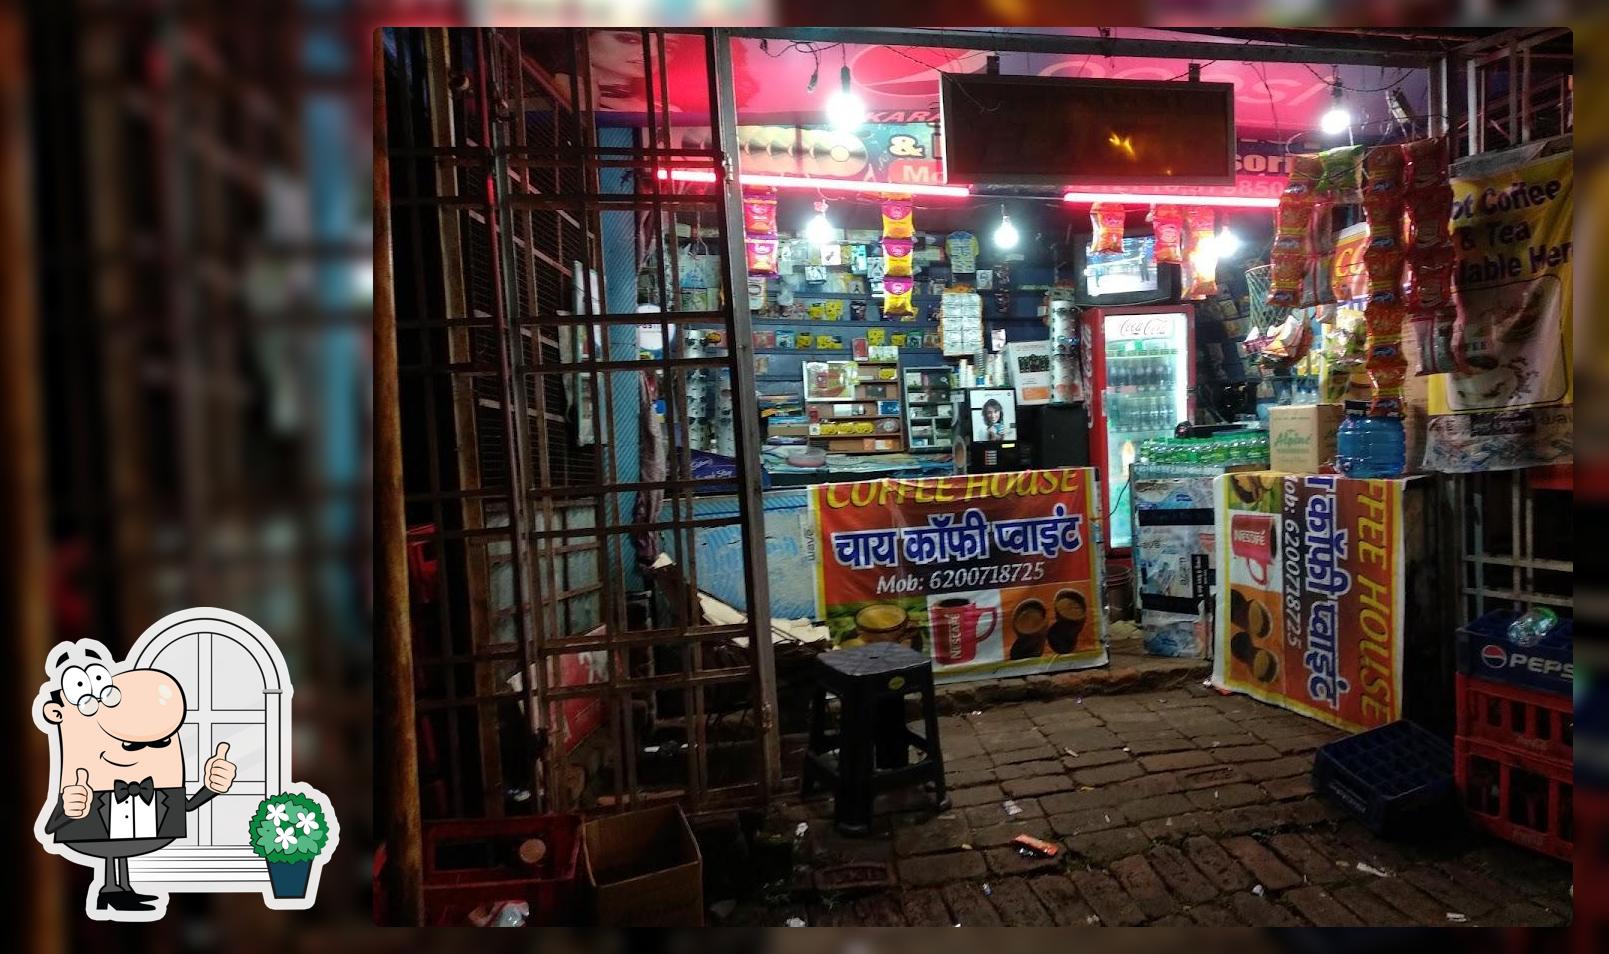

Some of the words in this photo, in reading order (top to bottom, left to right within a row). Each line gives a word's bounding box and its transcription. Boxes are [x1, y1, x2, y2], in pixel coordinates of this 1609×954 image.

[1484, 221, 1532, 248] Tea
[1528, 241, 1574, 274] Her
[963, 469, 1080, 502] HOUSE
[831, 528, 898, 570] चाय
[876, 574, 924, 595] Mob:
[929, 562, 1046, 590] 6200718725
[1284, 519, 1302, 648] 6200718725
[1358, 575, 1391, 724] HOUSE
[1510, 652, 1574, 679] PEPS
